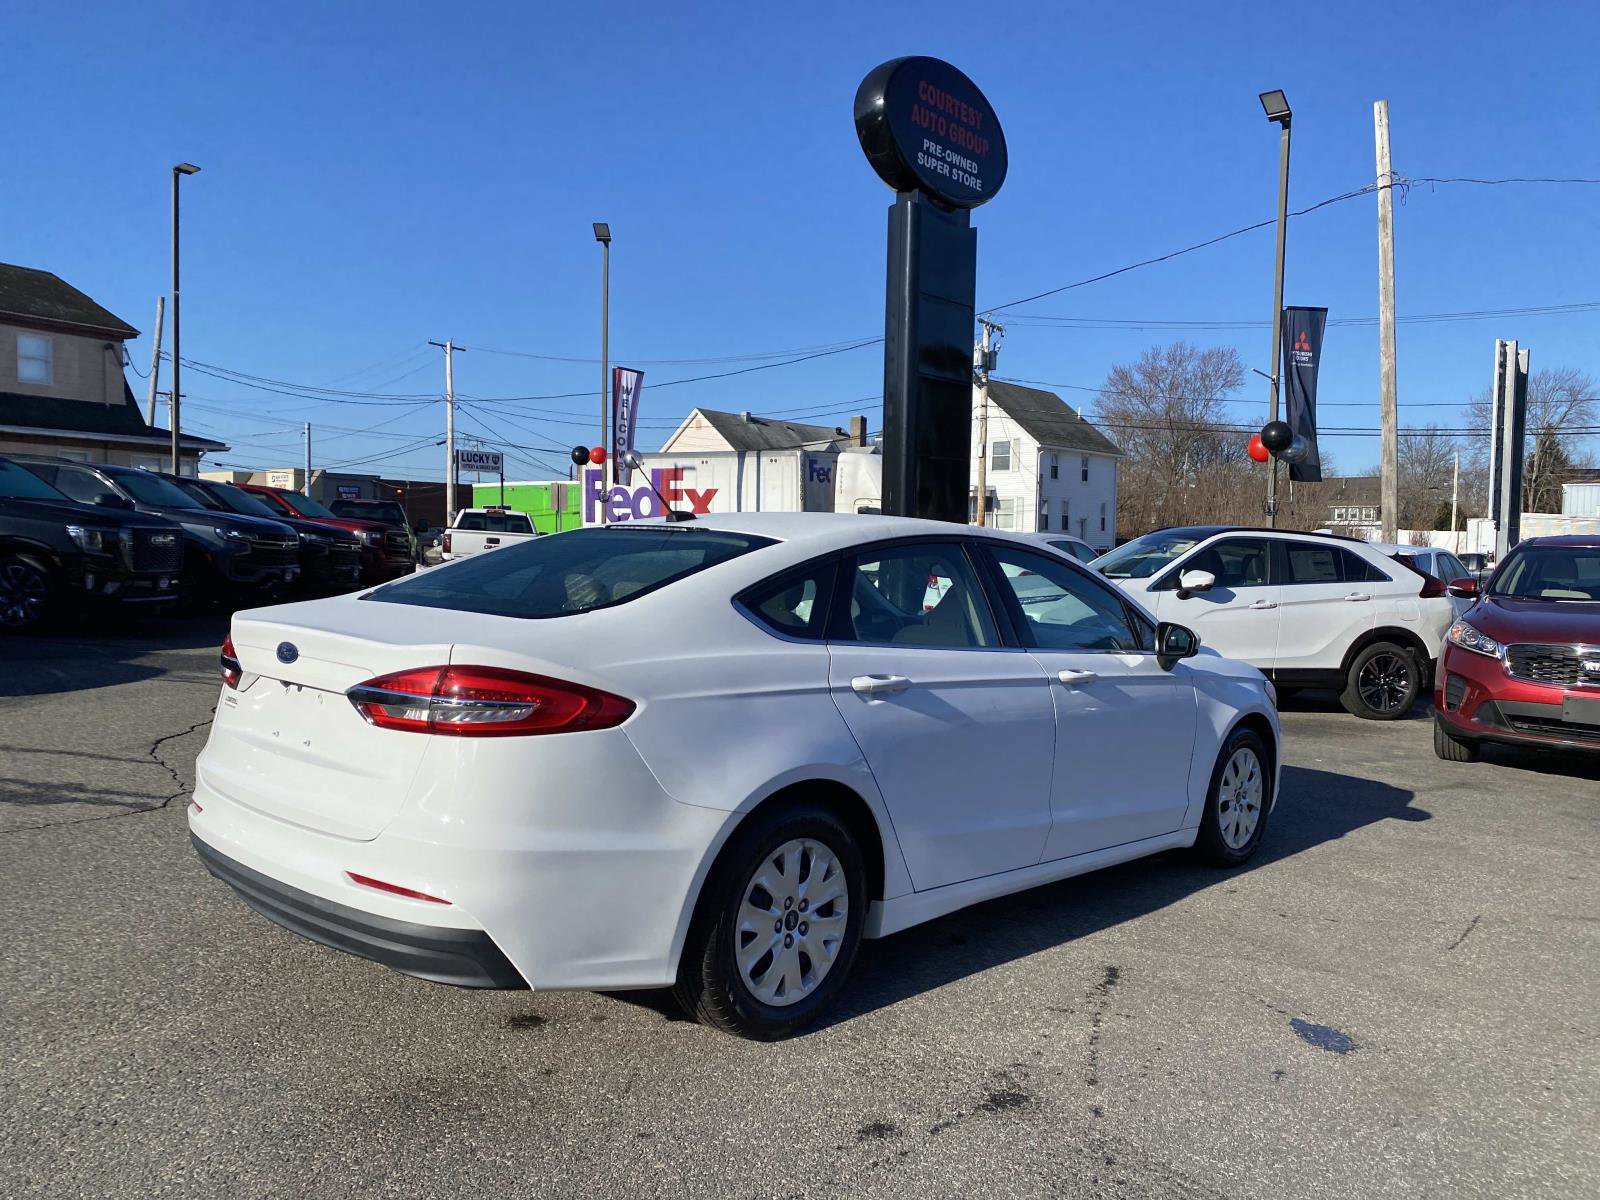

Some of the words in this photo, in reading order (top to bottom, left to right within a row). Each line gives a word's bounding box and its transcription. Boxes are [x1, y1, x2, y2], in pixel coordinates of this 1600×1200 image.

[918, 80, 983, 129] COURTESY
[912, 104, 946, 136] AUTO
[949, 123, 989, 157] GROUP
[917, 151, 950, 176] SUPER
[952, 169, 982, 191] STORE
[923, 138, 978, 174] PRE-OWNED
[461, 452, 490, 464] LUCKY
[585, 468, 718, 523] FedEx
